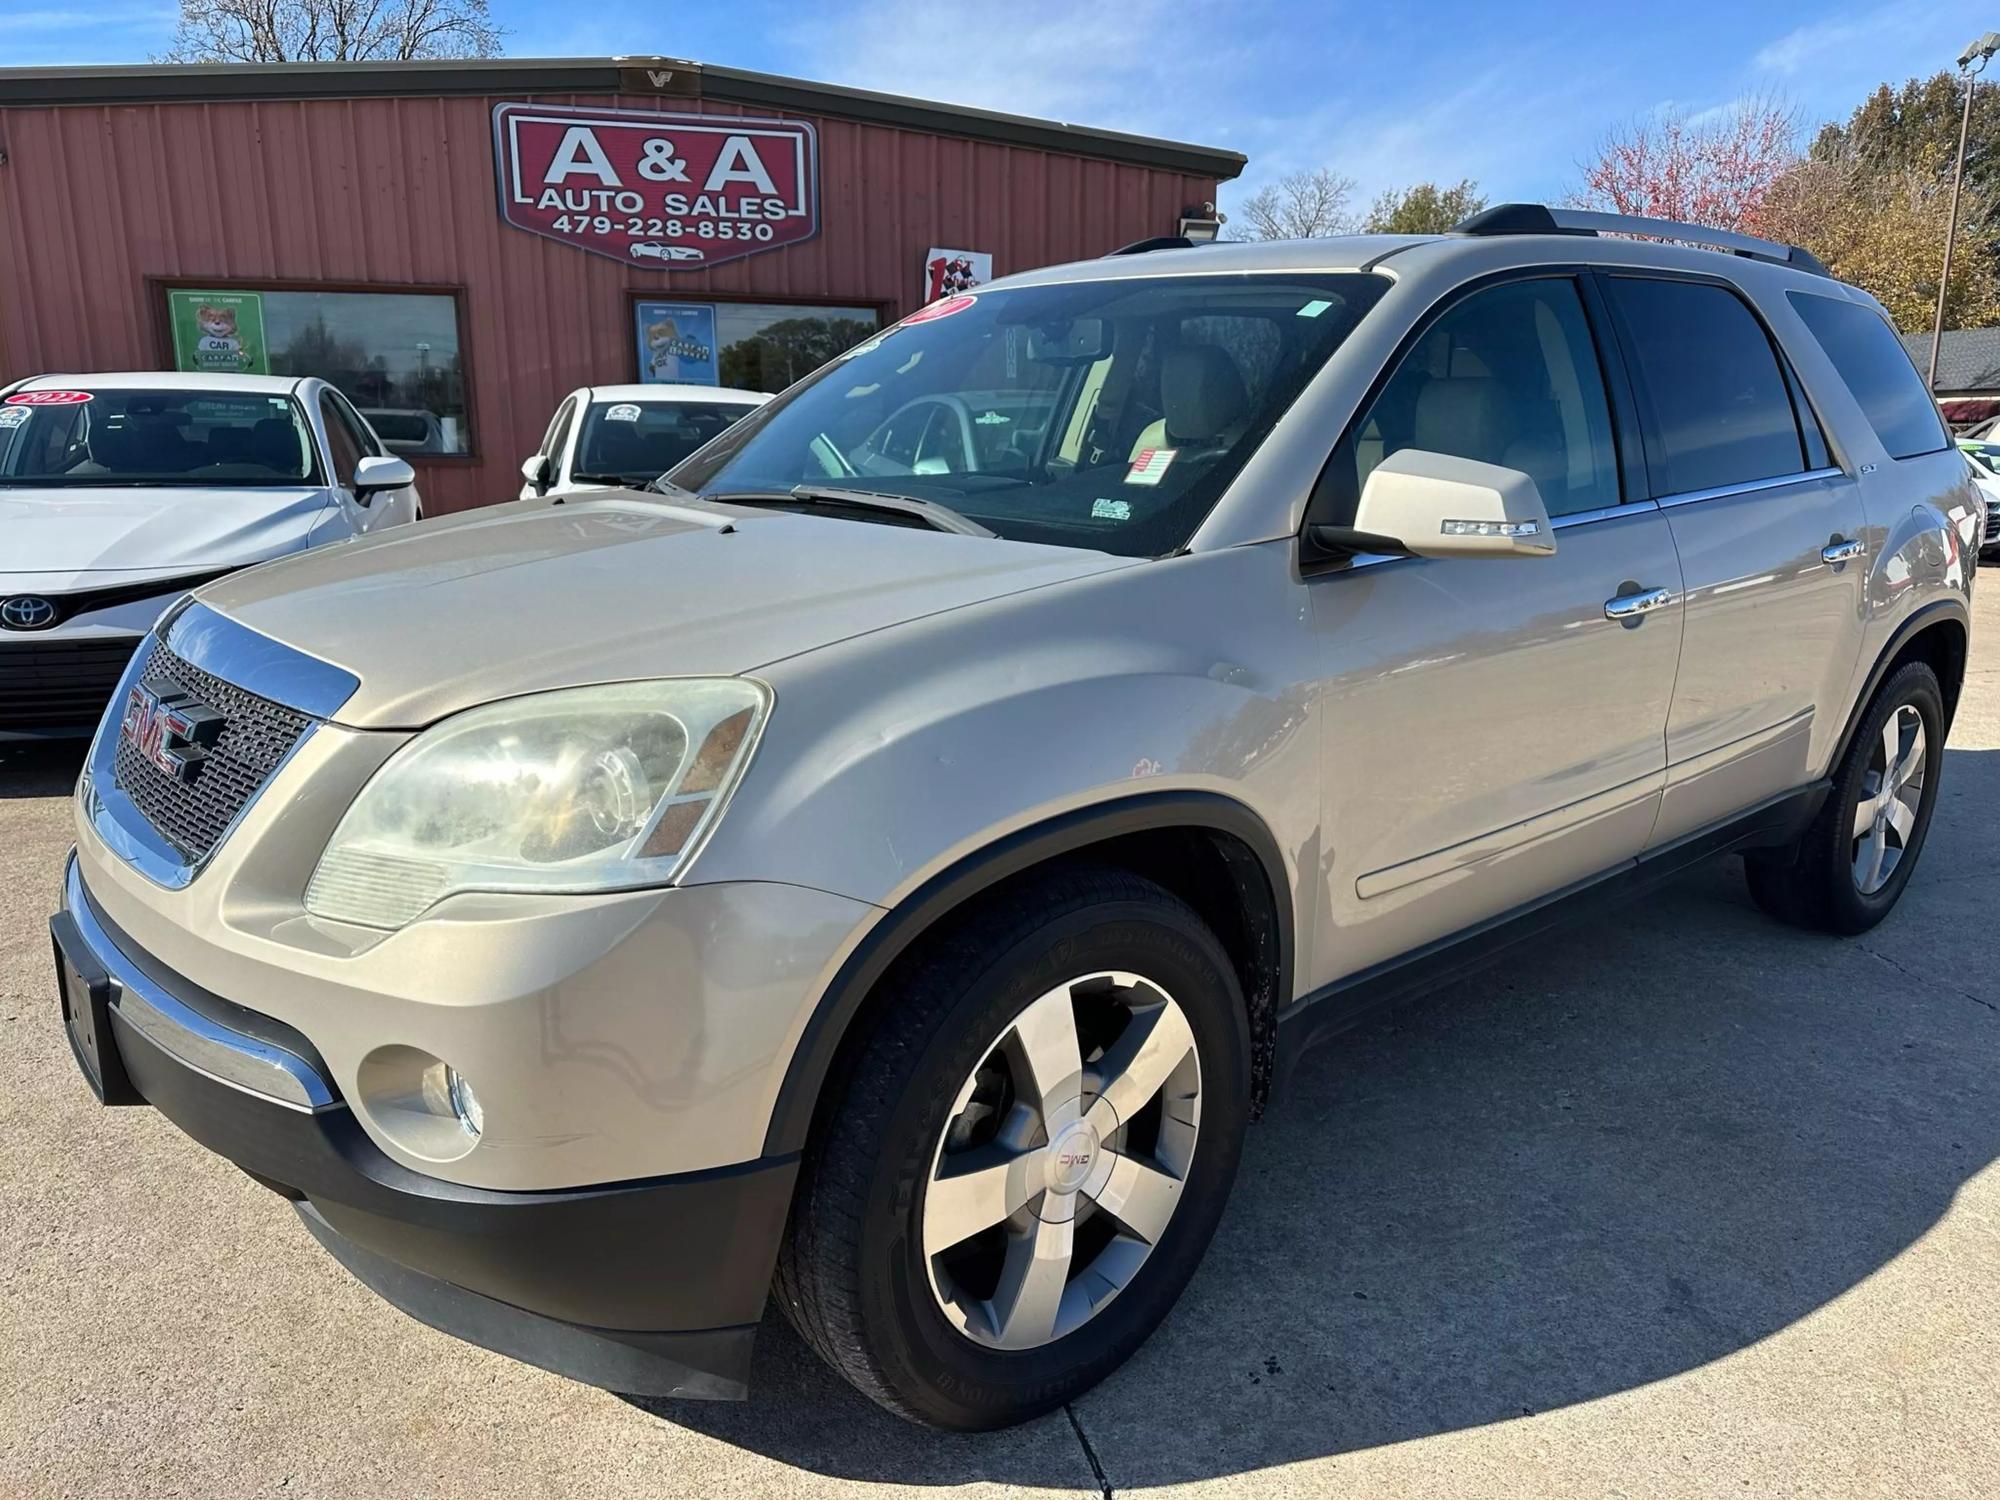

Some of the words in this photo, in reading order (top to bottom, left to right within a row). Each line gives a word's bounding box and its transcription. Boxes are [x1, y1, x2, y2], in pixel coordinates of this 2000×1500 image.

[544, 126, 624, 187] A
[637, 138, 693, 183] &
[704, 136, 779, 195] A
[537, 188, 644, 214] AUTO
[665, 194, 788, 220] SALES
[552, 215, 774, 241] 479-228-8530
[209, 340, 229, 350] CAR
[121, 684, 197, 780] GMC
[1060, 1154, 1090, 1167] GMC
